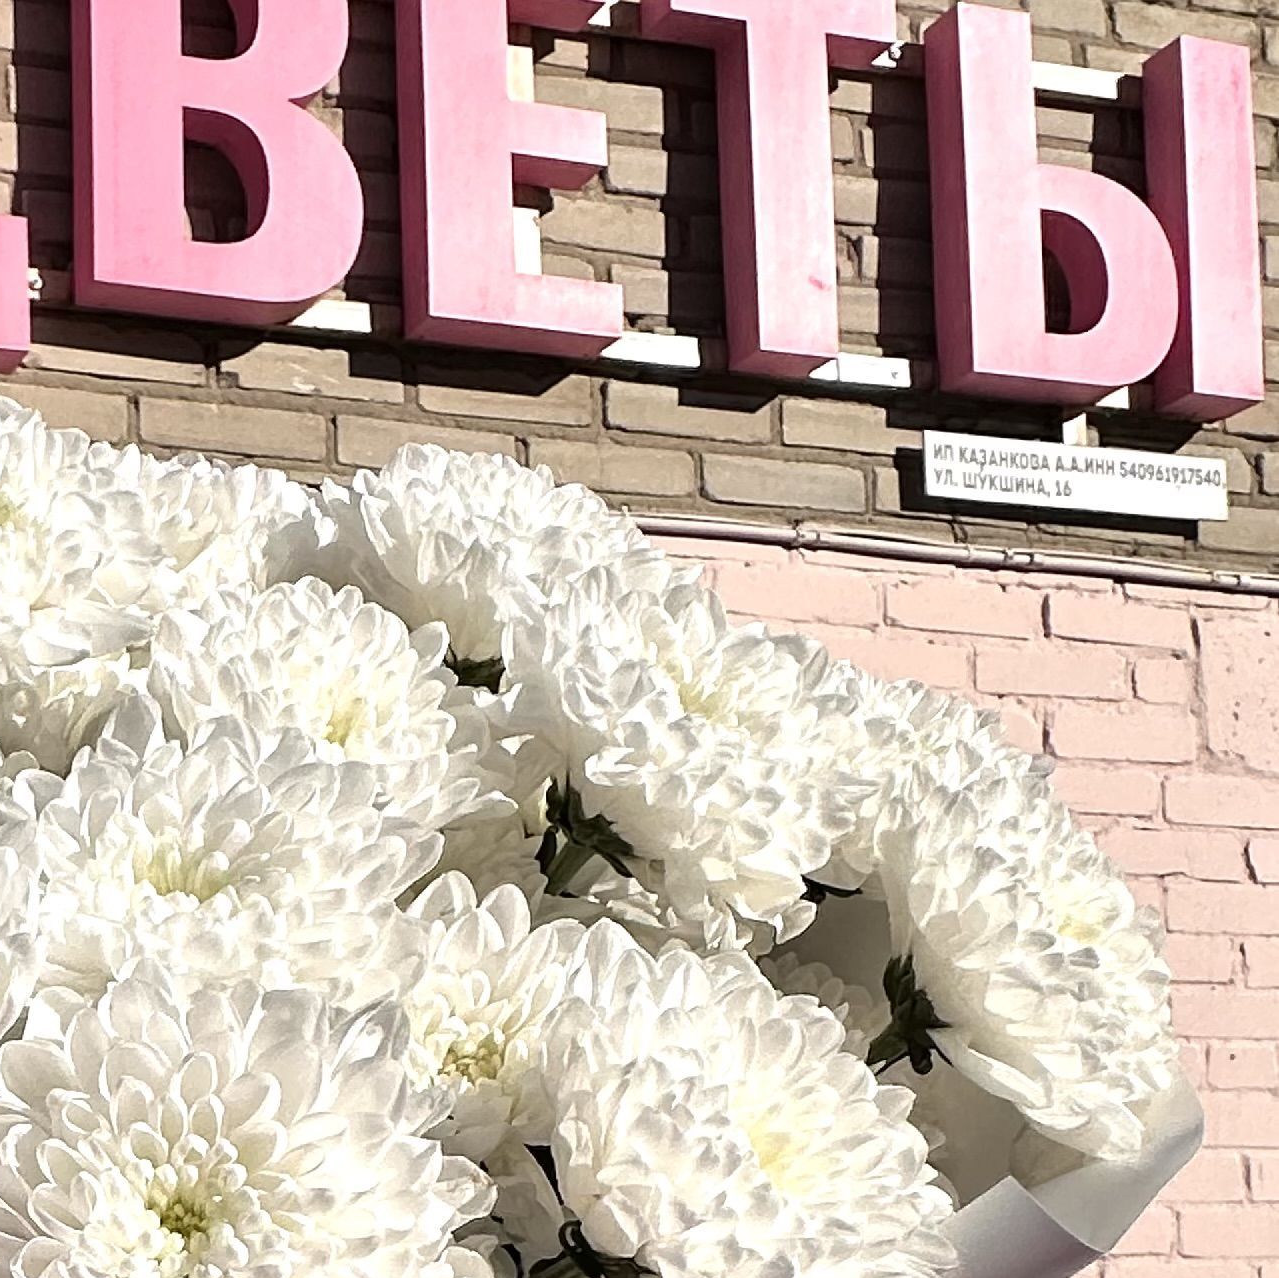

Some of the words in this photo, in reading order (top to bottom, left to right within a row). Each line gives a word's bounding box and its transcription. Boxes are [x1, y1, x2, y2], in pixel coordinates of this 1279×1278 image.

[933, 443, 954, 461] ИП
[959, 446, 1050, 472] КАЗАНКОВА
[933, 468, 958, 486] УЛ.
[962, 471, 1051, 498] ШУКШИНА,
[1055, 479, 1072, 497] 16
